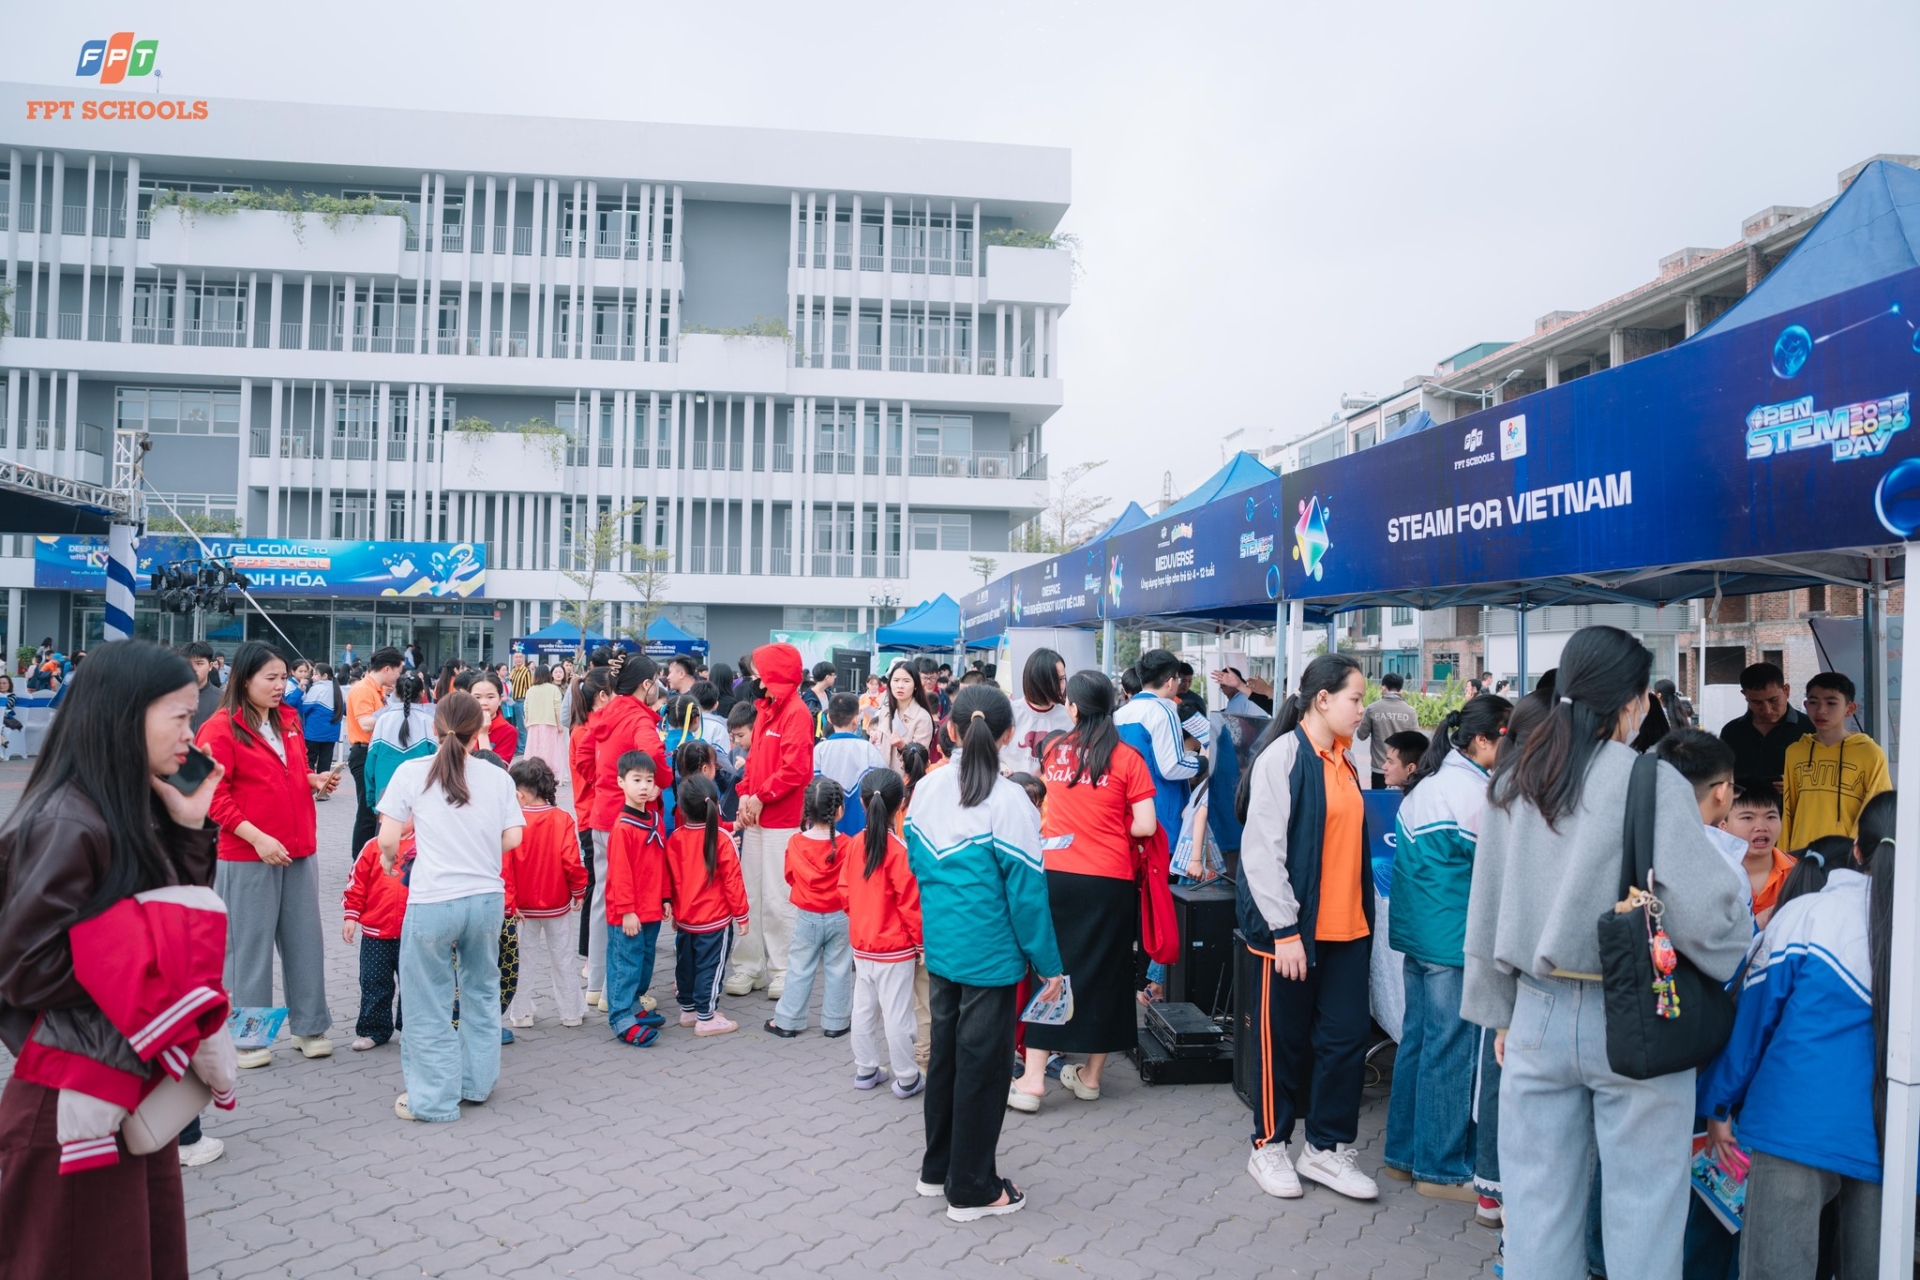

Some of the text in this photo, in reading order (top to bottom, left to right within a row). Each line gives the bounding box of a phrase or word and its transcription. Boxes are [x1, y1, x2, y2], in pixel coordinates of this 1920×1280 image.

[1850, 397, 1906, 421] 2025
[1749, 409, 1850, 456] STEM
[1850, 412, 1908, 436] 2026
[1835, 431, 1891, 458] DAY
[1454, 452, 1495, 470] FPT SCHOOLS
[1387, 470, 1633, 543] STEAM FOR VIETNAM
[268, 560, 329, 568] SCHOOL
[1155, 549, 1194, 571] MEDUVERSE
[281, 571, 328, 587] HÓA
[1046, 765, 1109, 787] Sakua
